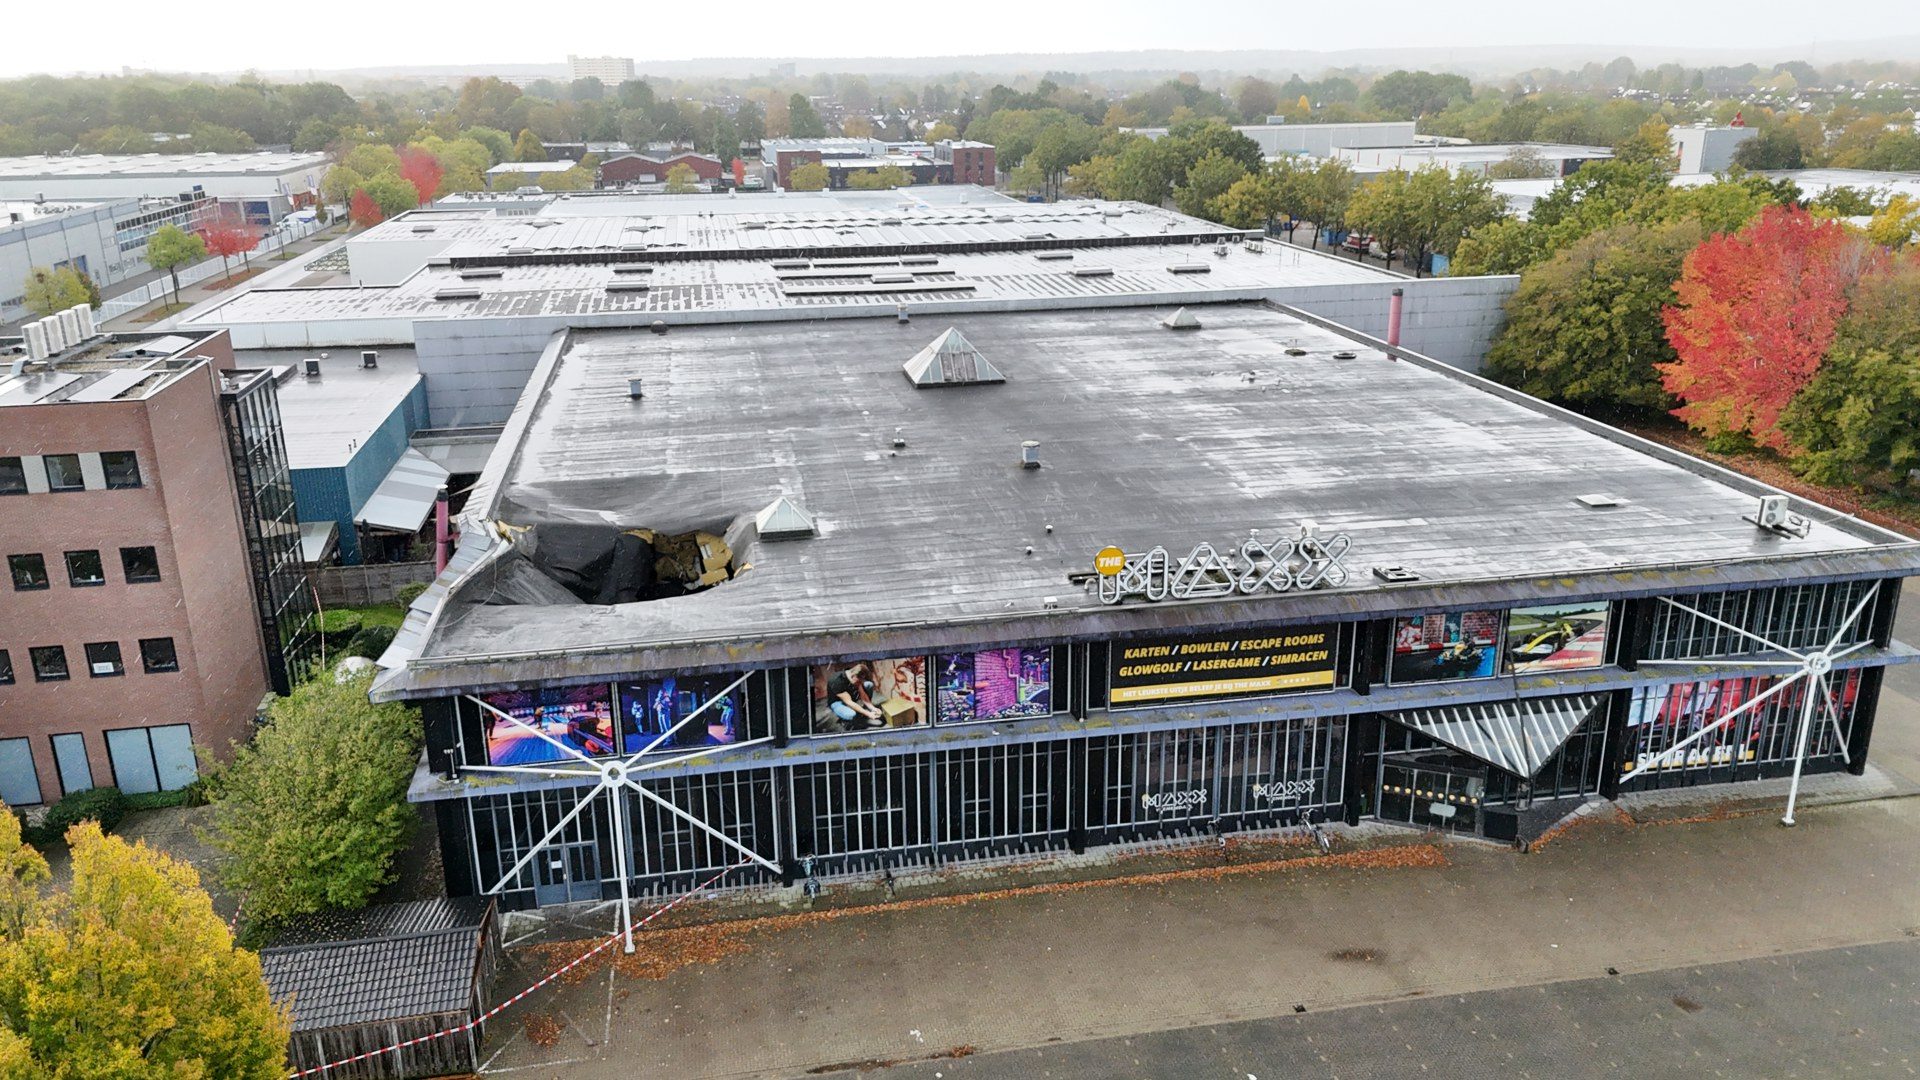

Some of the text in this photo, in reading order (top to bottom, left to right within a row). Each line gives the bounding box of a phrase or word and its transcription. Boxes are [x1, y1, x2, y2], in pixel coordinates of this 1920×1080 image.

[1098, 556, 1122, 567] THE
[1098, 533, 1352, 604] MAXX
[1124, 646, 1171, 659] KARTEN
[1180, 641, 1230, 655] BOWLEN
[1240, 637, 1282, 651] ESCAPE
[1284, 633, 1325, 646] ROOMS
[1119, 662, 1183, 677] GLOWGOLF
[1192, 656, 1262, 671] LASERGAME
[1270, 650, 1329, 666] SIMRACEN
[1122, 690, 1137, 698] HET
[1137, 687, 1168, 697] LEUKSTE
[1234, 681, 1248, 689] THE
[1248, 680, 1271, 688] MAXX
[1142, 789, 1207, 809] MAXX
[1253, 779, 1315, 799] MAXX
